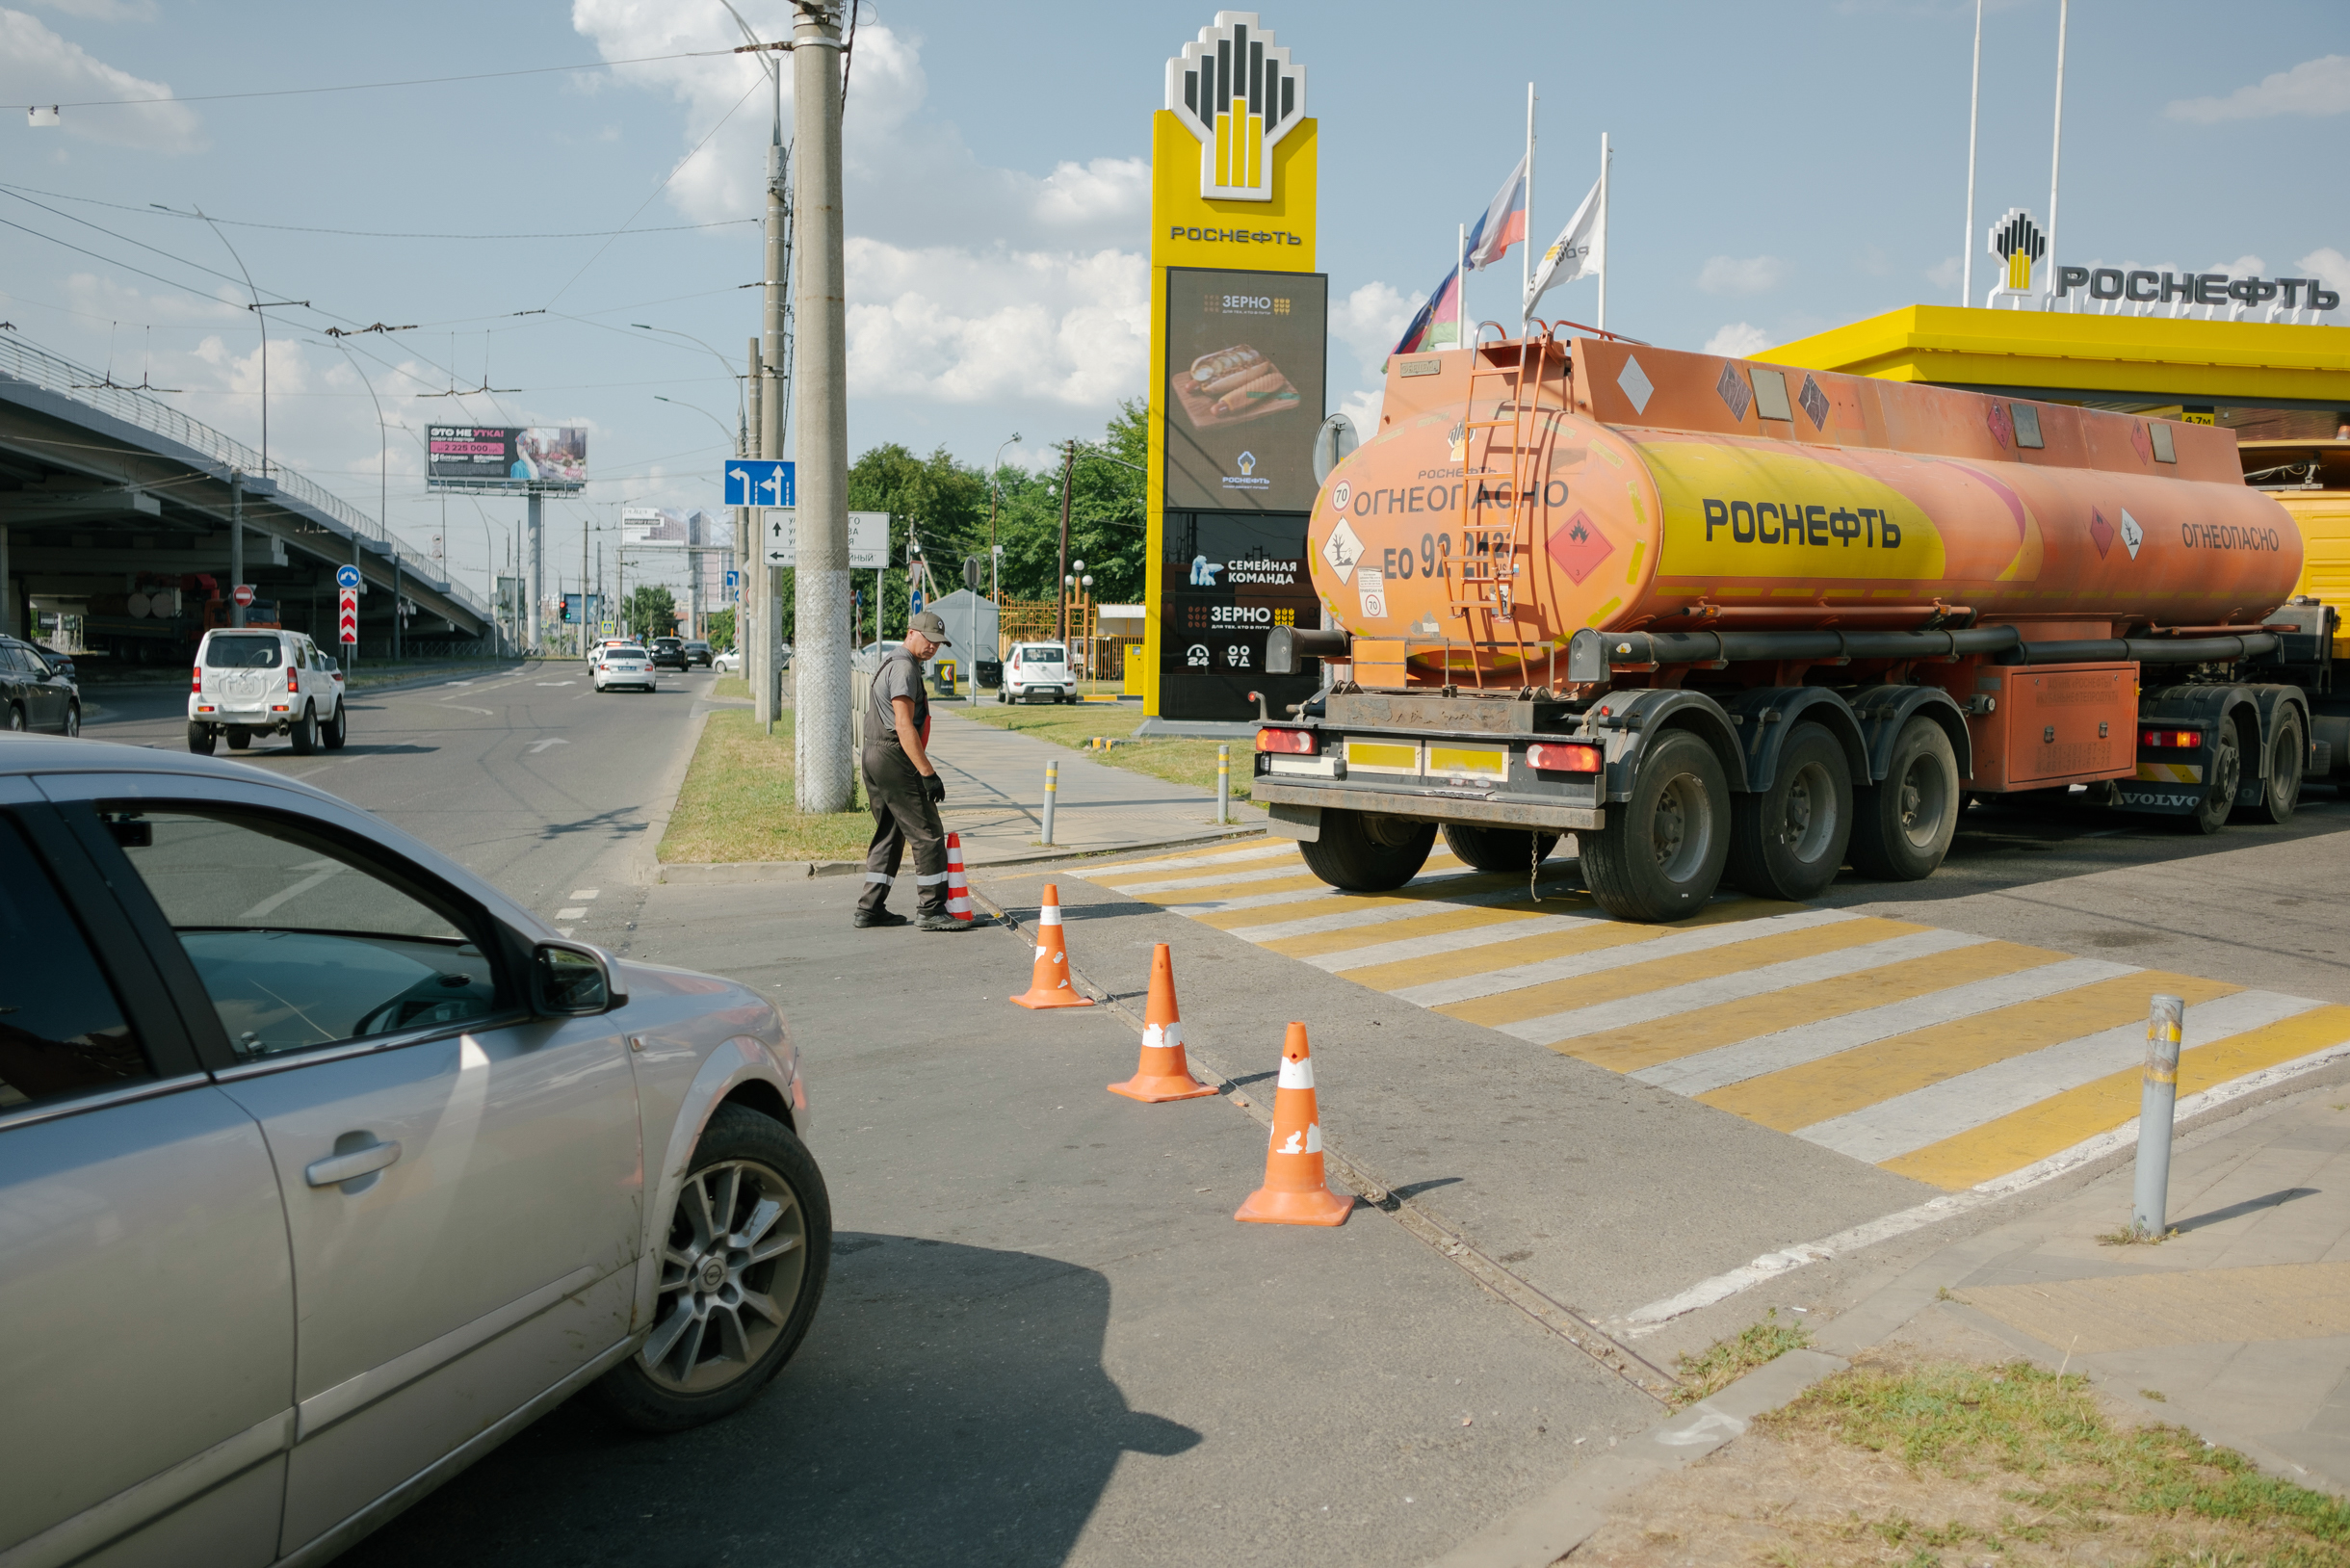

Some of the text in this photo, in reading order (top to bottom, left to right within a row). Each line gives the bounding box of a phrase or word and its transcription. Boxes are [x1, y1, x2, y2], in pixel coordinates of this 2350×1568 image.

[1170, 226, 1302, 245] РОСНЕФТЬ
[2056, 266, 2339, 310] РОСНЕФТЬ
[1222, 295, 1271, 309] ЗЕРНО
[431, 428, 455, 436] ЭТО
[456, 429, 472, 437] НЕ
[1222, 476, 1270, 484] РОСНЕФТЬ
[1336, 488, 1347, 503] 70
[1353, 481, 1569, 517] ОГНЕОПАСНО
[1703, 499, 1901, 548] РОСНЕФТЬ
[2181, 523, 2280, 552] ОГНЕОПАСНО
[1228, 559, 1297, 572] СЕМЕЙНАЯ
[1228, 572, 1294, 585] КОМАНДА
[1369, 601, 1378, 610] 70
[1211, 606, 1271, 623] ЗЕРНО
[1188, 657, 1210, 666] 24
[2122, 793, 2201, 806] VOLVO
